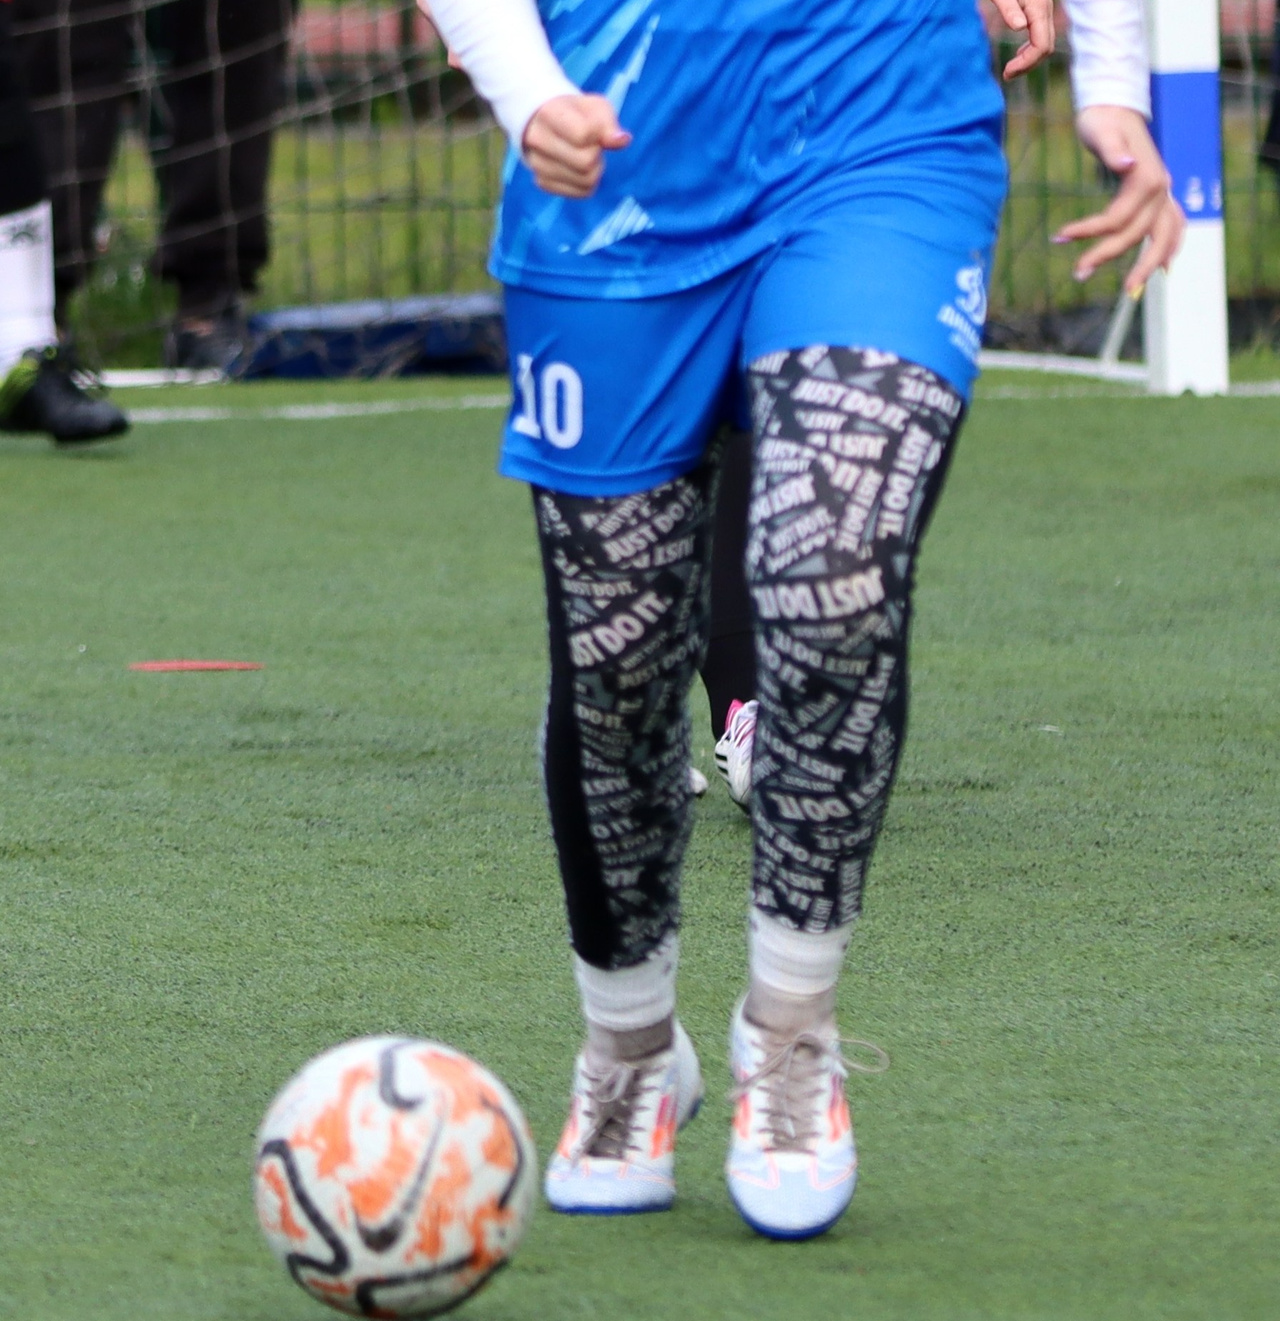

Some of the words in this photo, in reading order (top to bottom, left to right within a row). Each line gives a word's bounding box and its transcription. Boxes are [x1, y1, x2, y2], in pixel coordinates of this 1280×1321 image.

[512, 352, 583, 449] 10
[792, 378, 844, 408] JUST
[842, 391, 880, 416] DO
[895, 426, 933, 475] JUST
[887, 469, 913, 510] DO
[605, 521, 658, 563] JUST
[653, 502, 685, 533] DO
[780, 585, 820, 619] DO
[821, 566, 884, 616] JUST
[594, 612, 644, 654] DO
[848, 699, 881, 734] DO
[800, 751, 845, 782] JUST
[803, 795, 850, 825] DO
